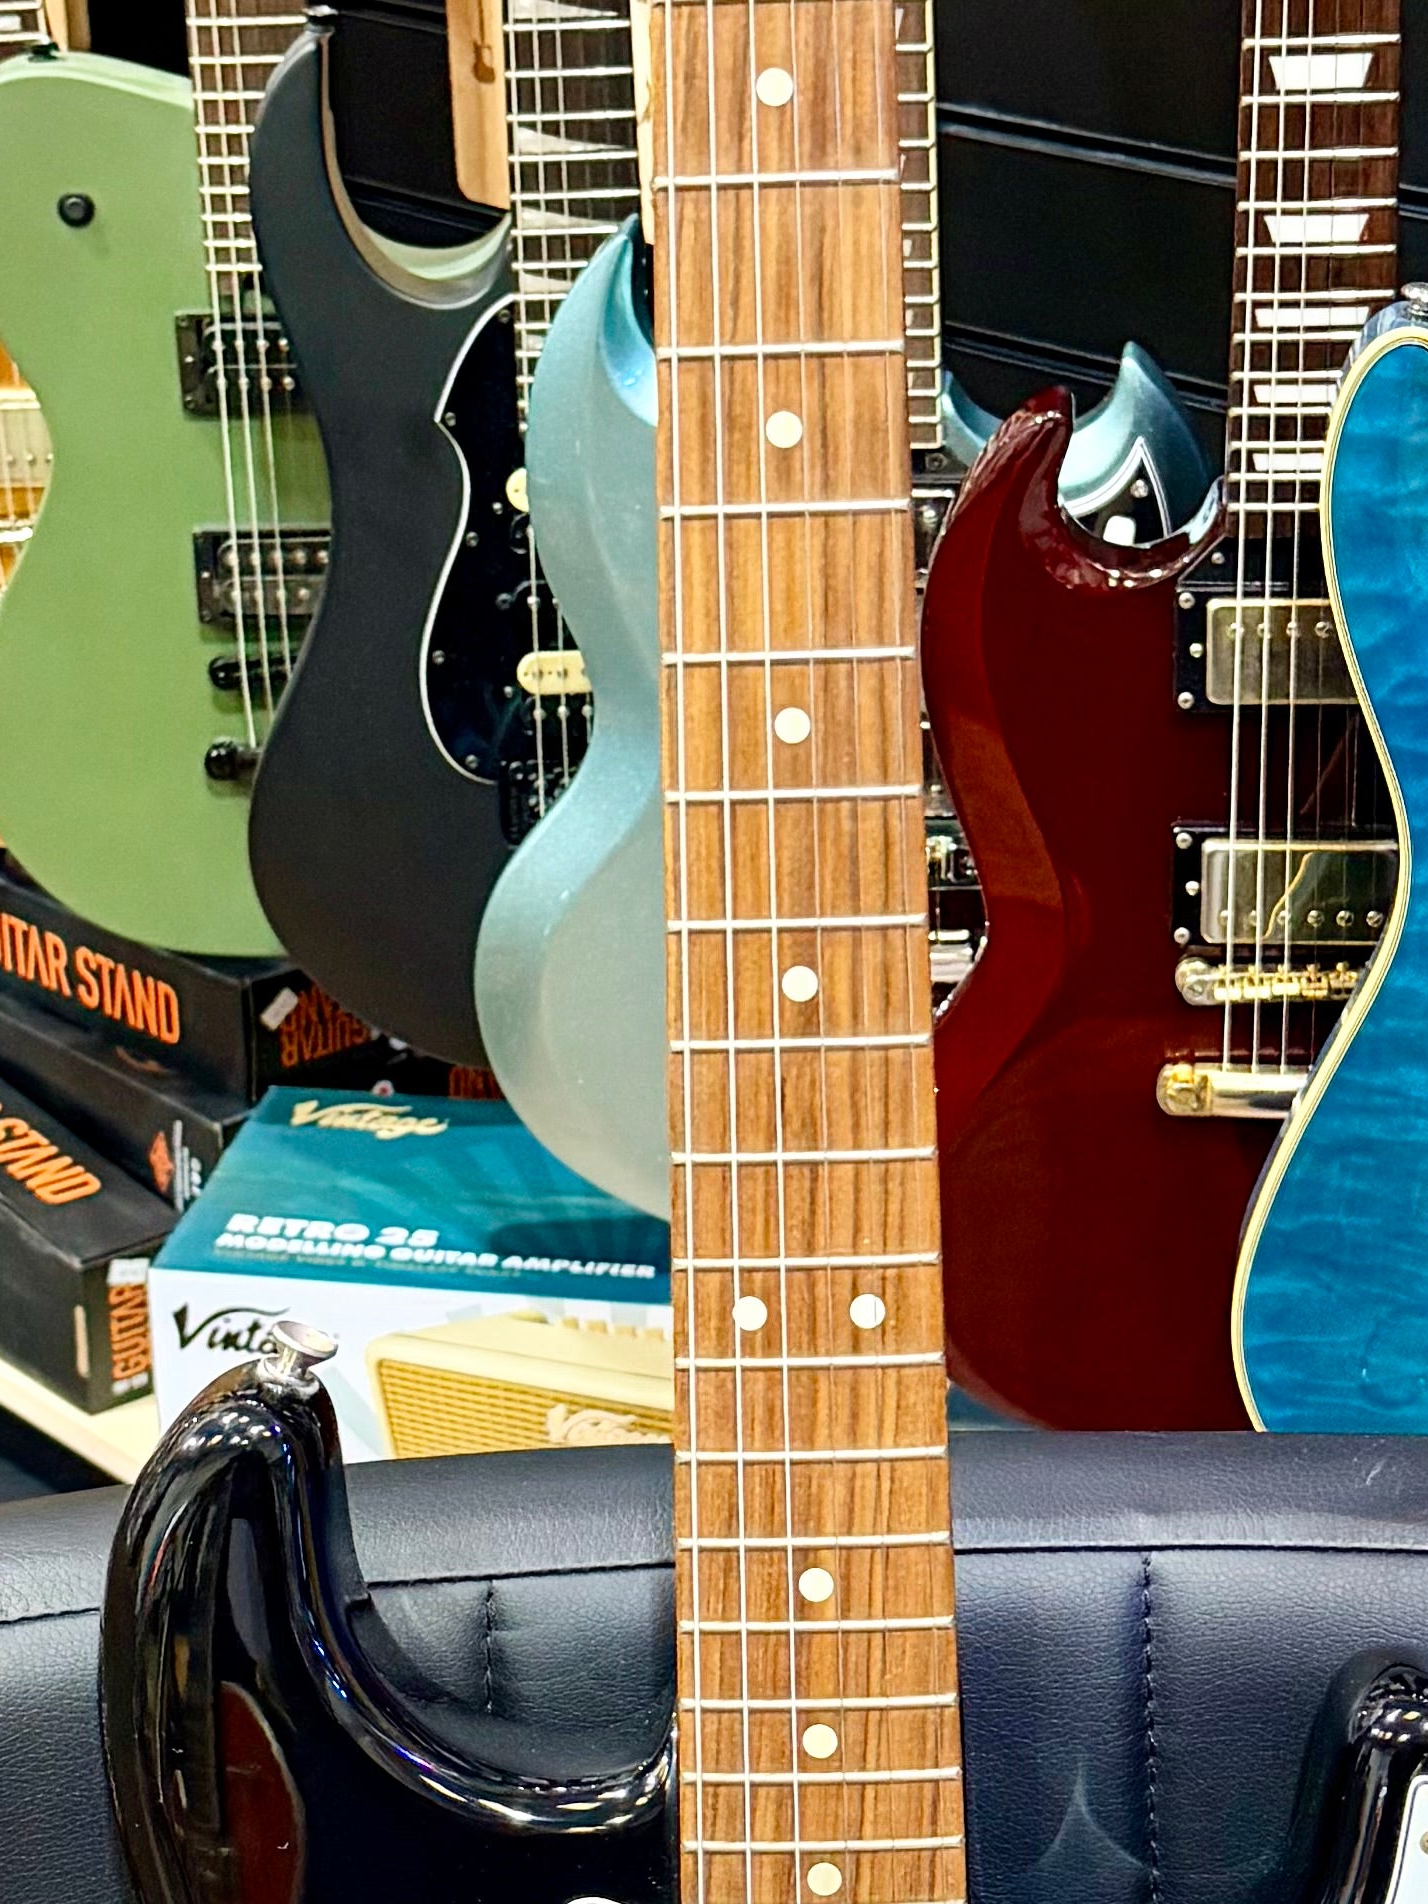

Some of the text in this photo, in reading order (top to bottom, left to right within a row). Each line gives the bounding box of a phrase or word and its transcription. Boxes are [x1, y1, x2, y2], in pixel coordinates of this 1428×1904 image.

[75, 946, 180, 1044] STAND
[290, 1100, 449, 1140] Vintage
[226, 1213, 439, 1248] RETRO 25
[215, 1233, 656, 1279] MODELLING GUITAR AMPLIFIER
[109, 1281, 149, 1382] GUITAR
